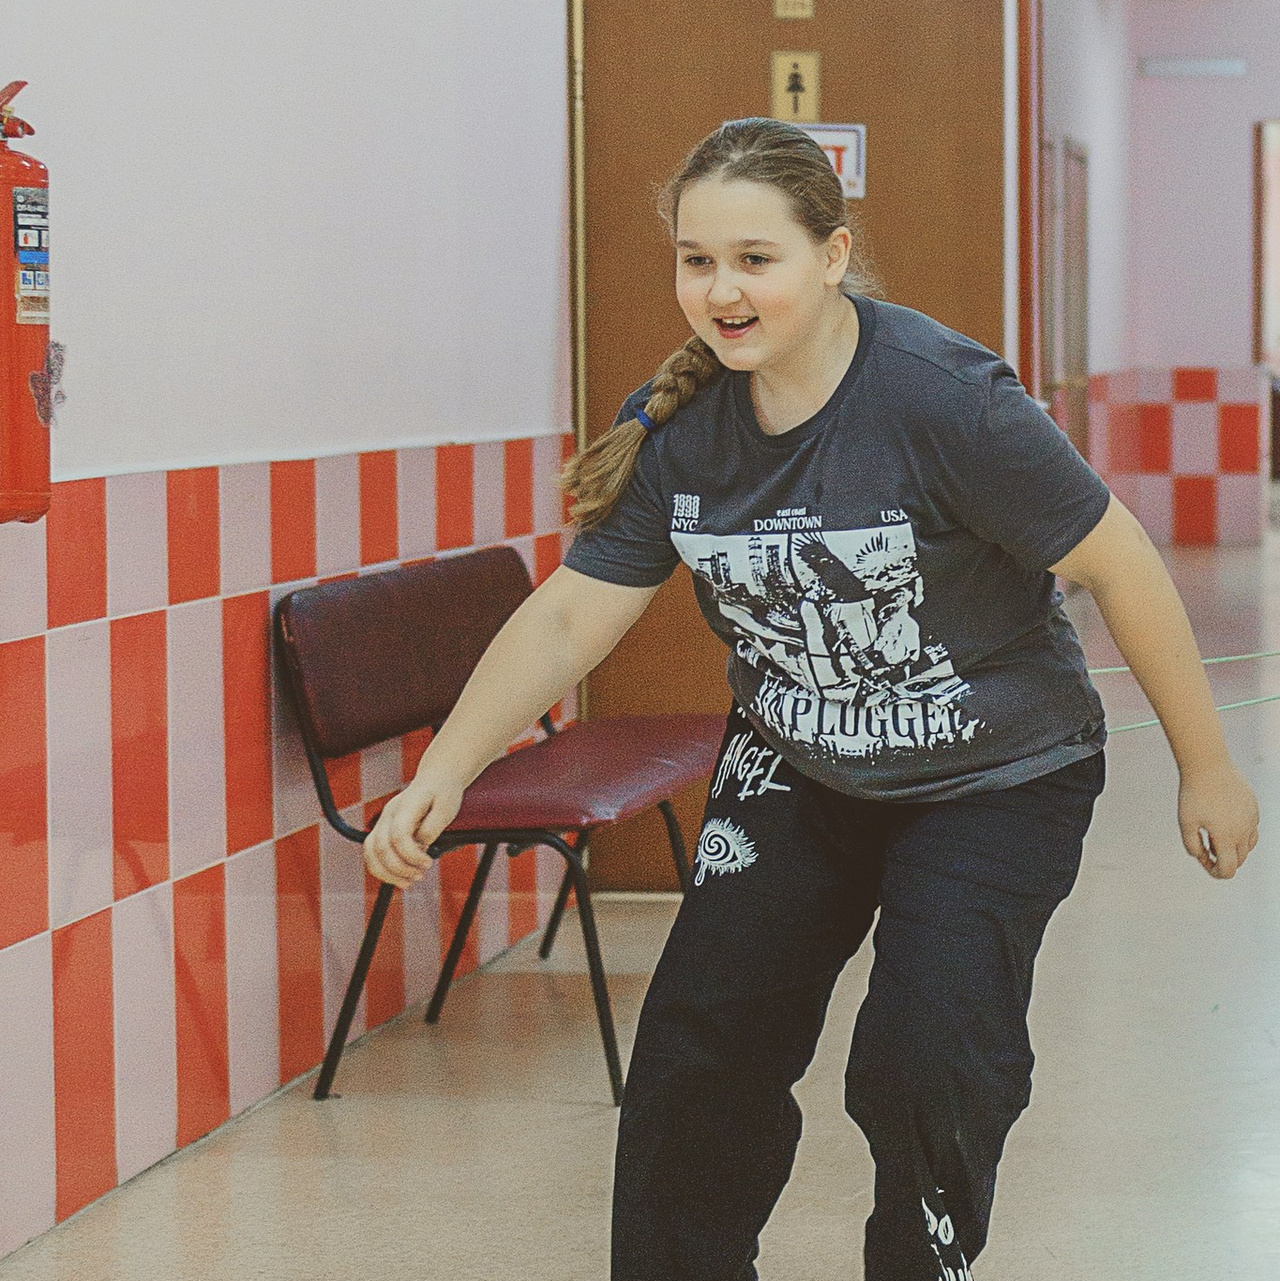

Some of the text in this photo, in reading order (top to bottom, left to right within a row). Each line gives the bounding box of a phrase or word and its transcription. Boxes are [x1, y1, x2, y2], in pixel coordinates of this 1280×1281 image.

[880, 509, 909, 523] USA
[671, 517, 699, 532] NYC
[754, 516, 822, 532] DOWNTOWN
[711, 730, 791, 802] ANGEL
